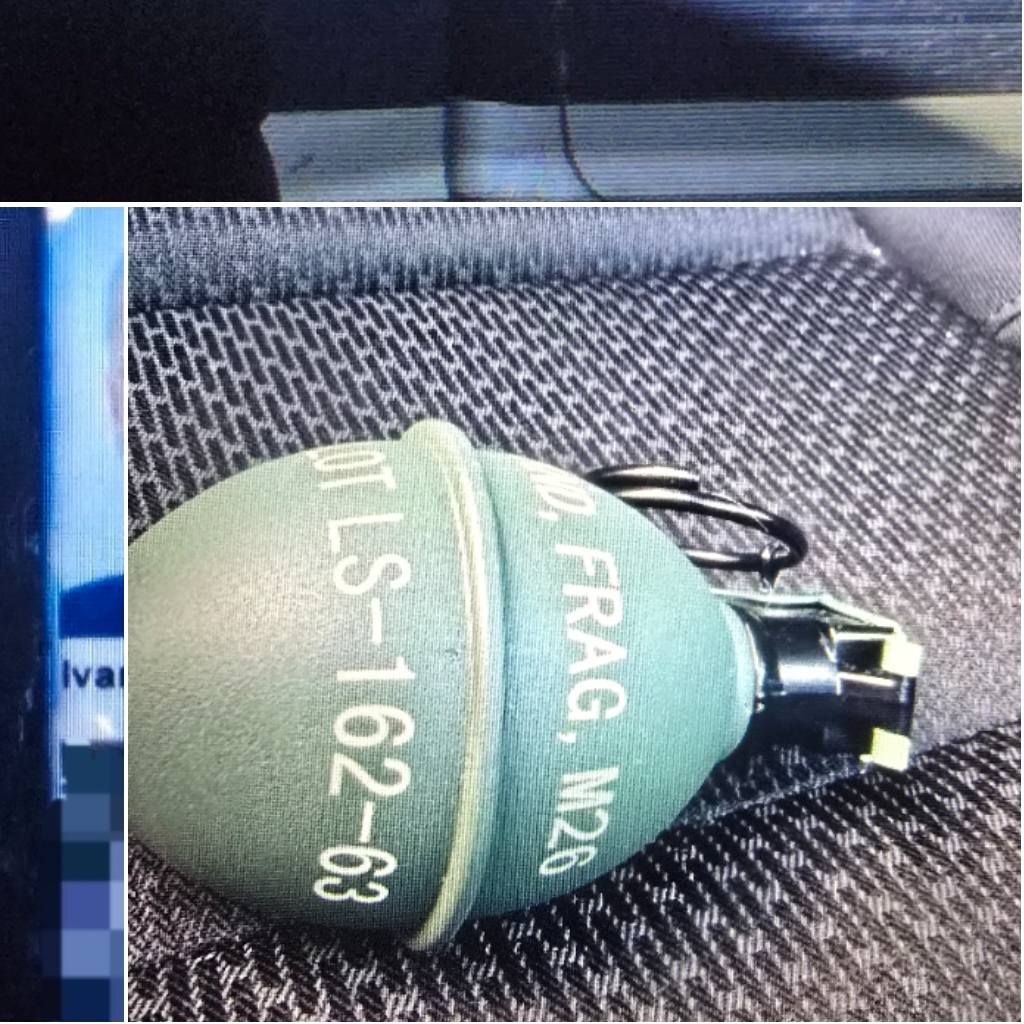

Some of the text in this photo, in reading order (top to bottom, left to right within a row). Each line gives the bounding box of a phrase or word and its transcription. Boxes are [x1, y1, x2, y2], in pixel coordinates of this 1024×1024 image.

[63, 659, 124, 689] Iva
[312, 512, 417, 905] LS-162-63
[556, 543, 628, 745] FRAG,
[538, 766, 621, 878] M26
